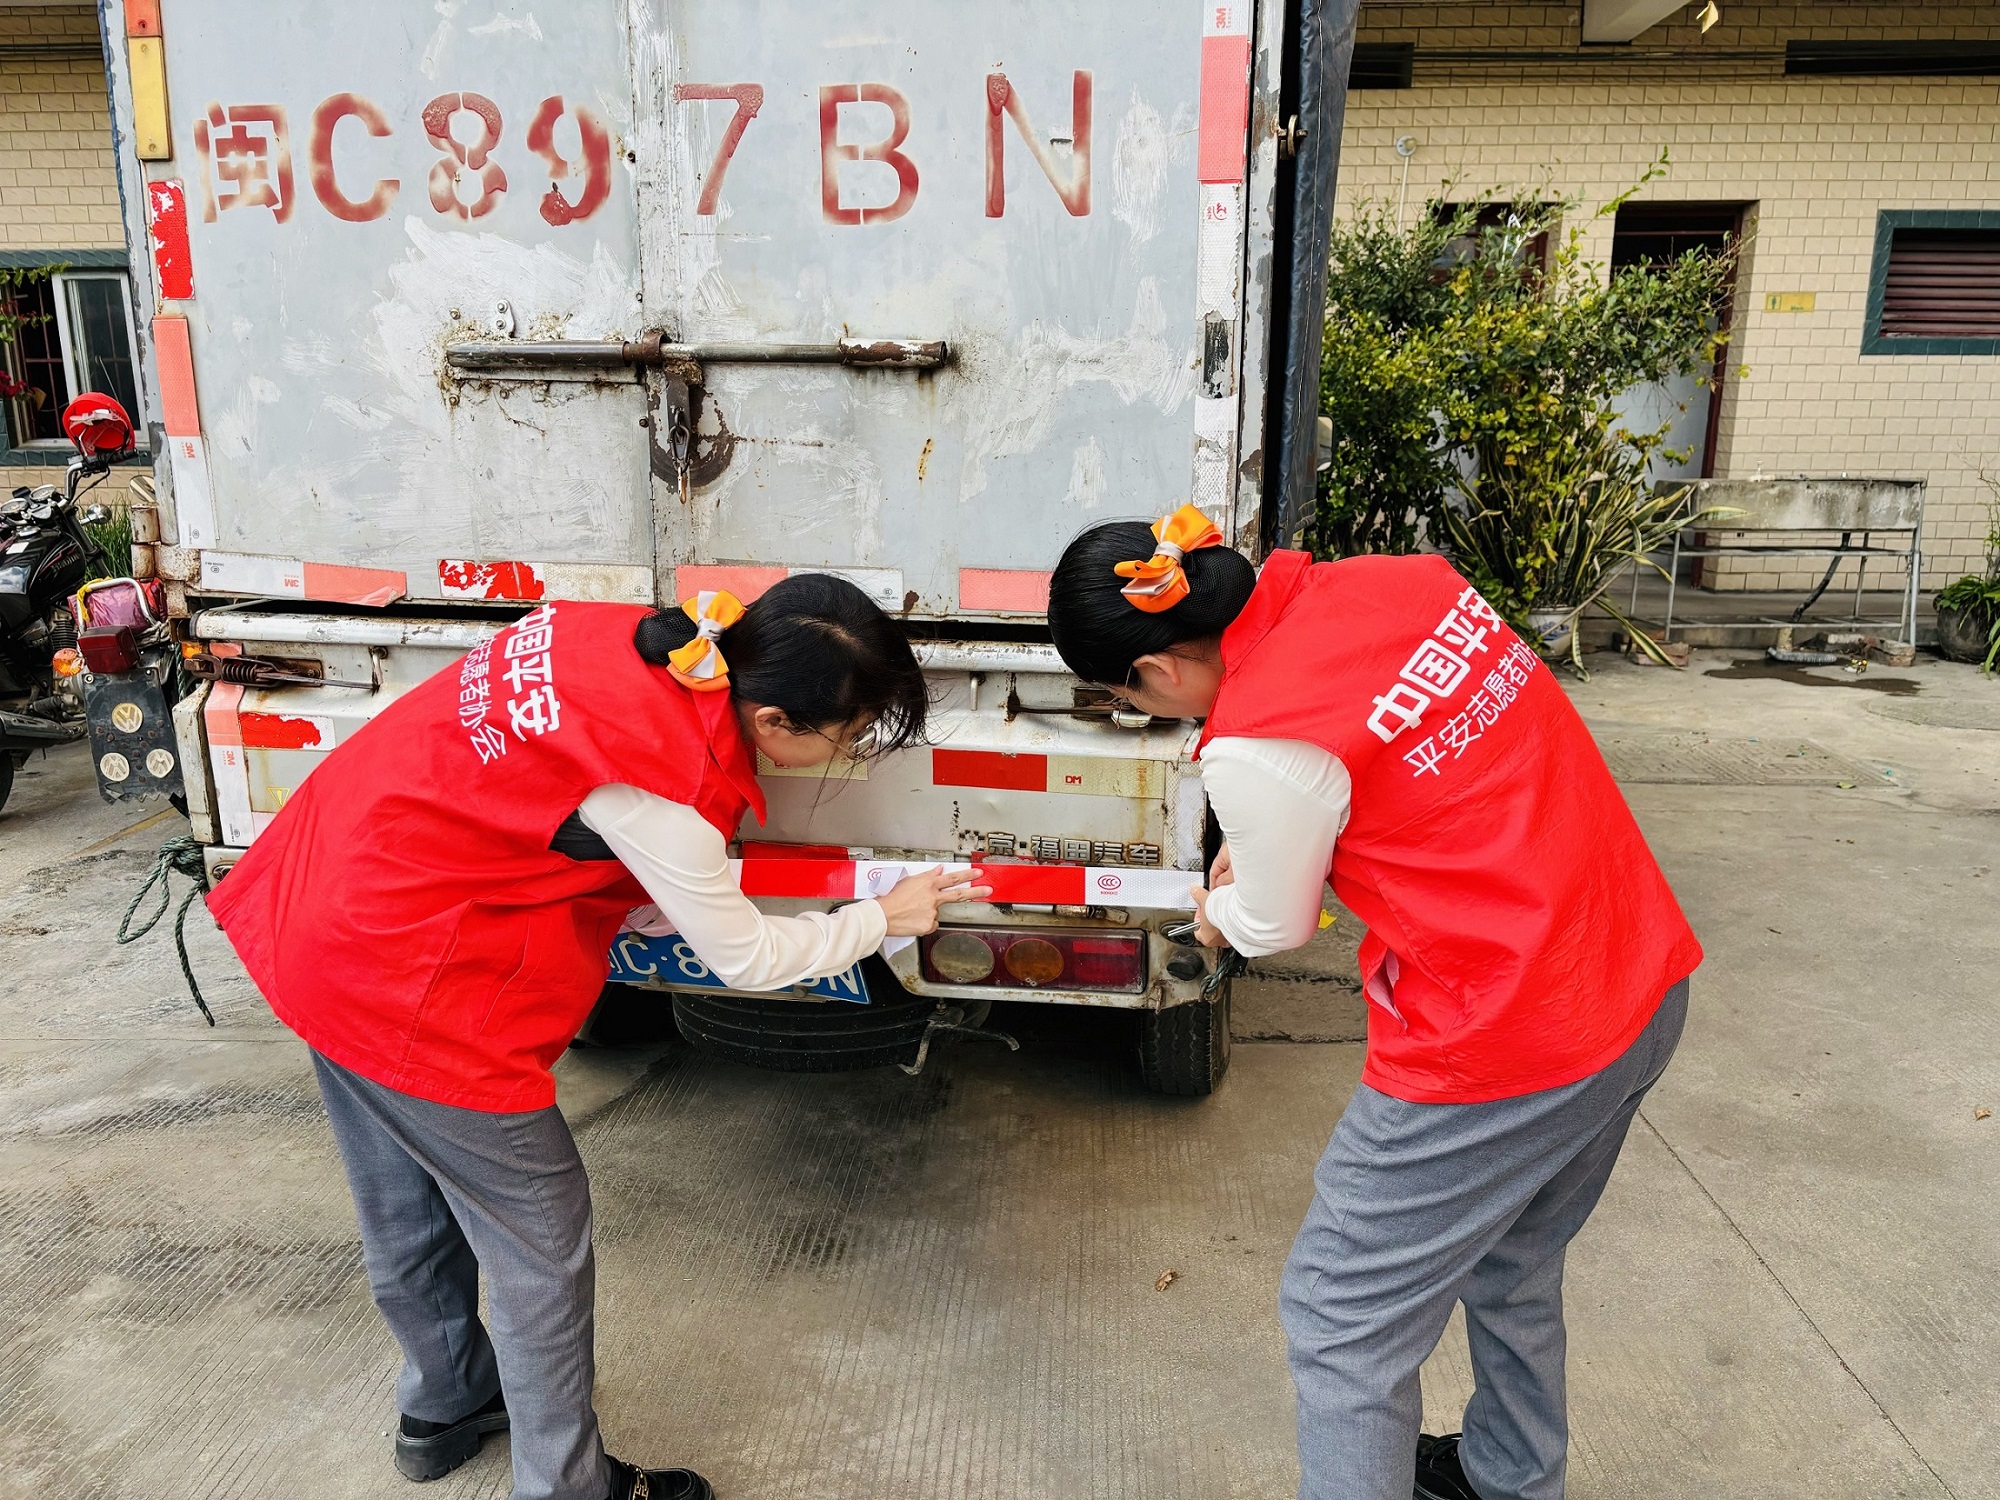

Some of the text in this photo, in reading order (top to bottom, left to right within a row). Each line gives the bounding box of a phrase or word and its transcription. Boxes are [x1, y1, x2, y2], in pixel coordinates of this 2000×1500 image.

[1215, 7, 1227, 29] 3M
[184, 441, 197, 460] 3M
[284, 578, 300, 588] 3M
[502, 603, 561, 742] 中国平安
[1366, 586, 1504, 744] 中国平安
[1403, 637, 1539, 777] 平安志愿者协
[226, 750, 236, 766] 3M
[1064, 775, 1083, 785] DM
[960, 830, 1161, 867] 京·福田汽车
